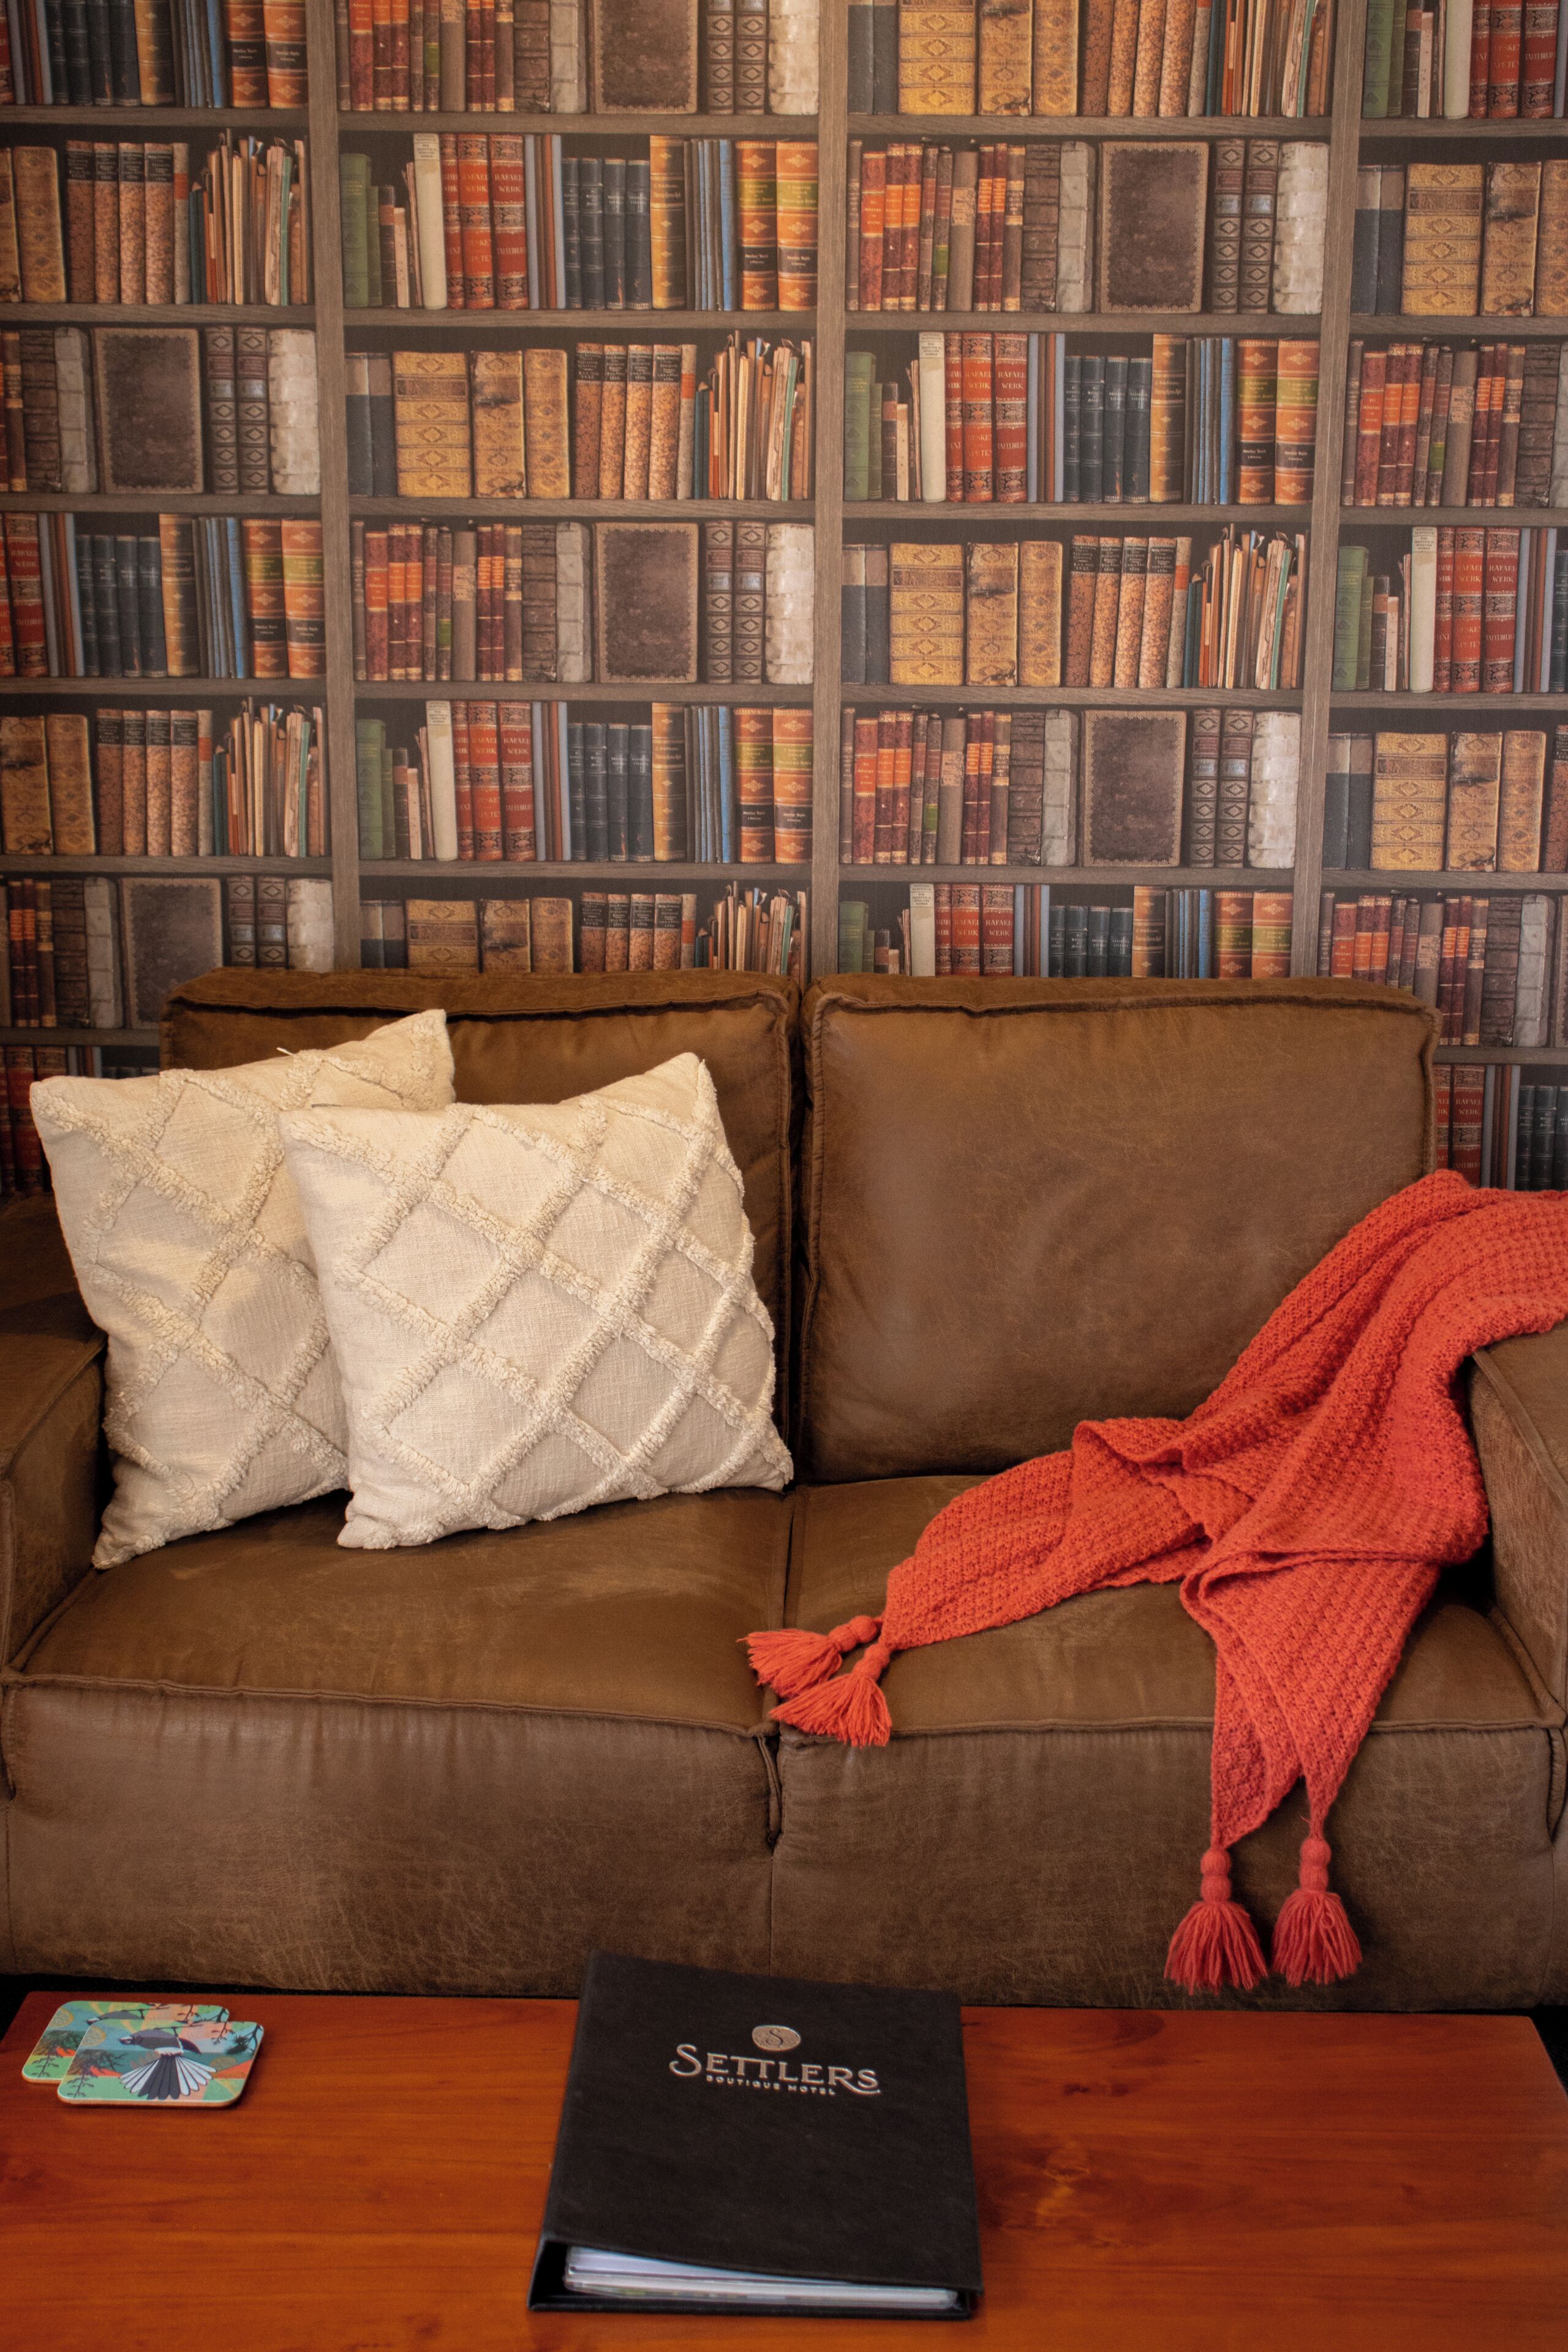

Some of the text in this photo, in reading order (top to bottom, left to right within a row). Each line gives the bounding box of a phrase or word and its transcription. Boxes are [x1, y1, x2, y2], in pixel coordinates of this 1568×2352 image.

[669, 2043, 882, 2095] SETTLERS
[706, 2074, 835, 2095] BOUTIQUE MOTEL
